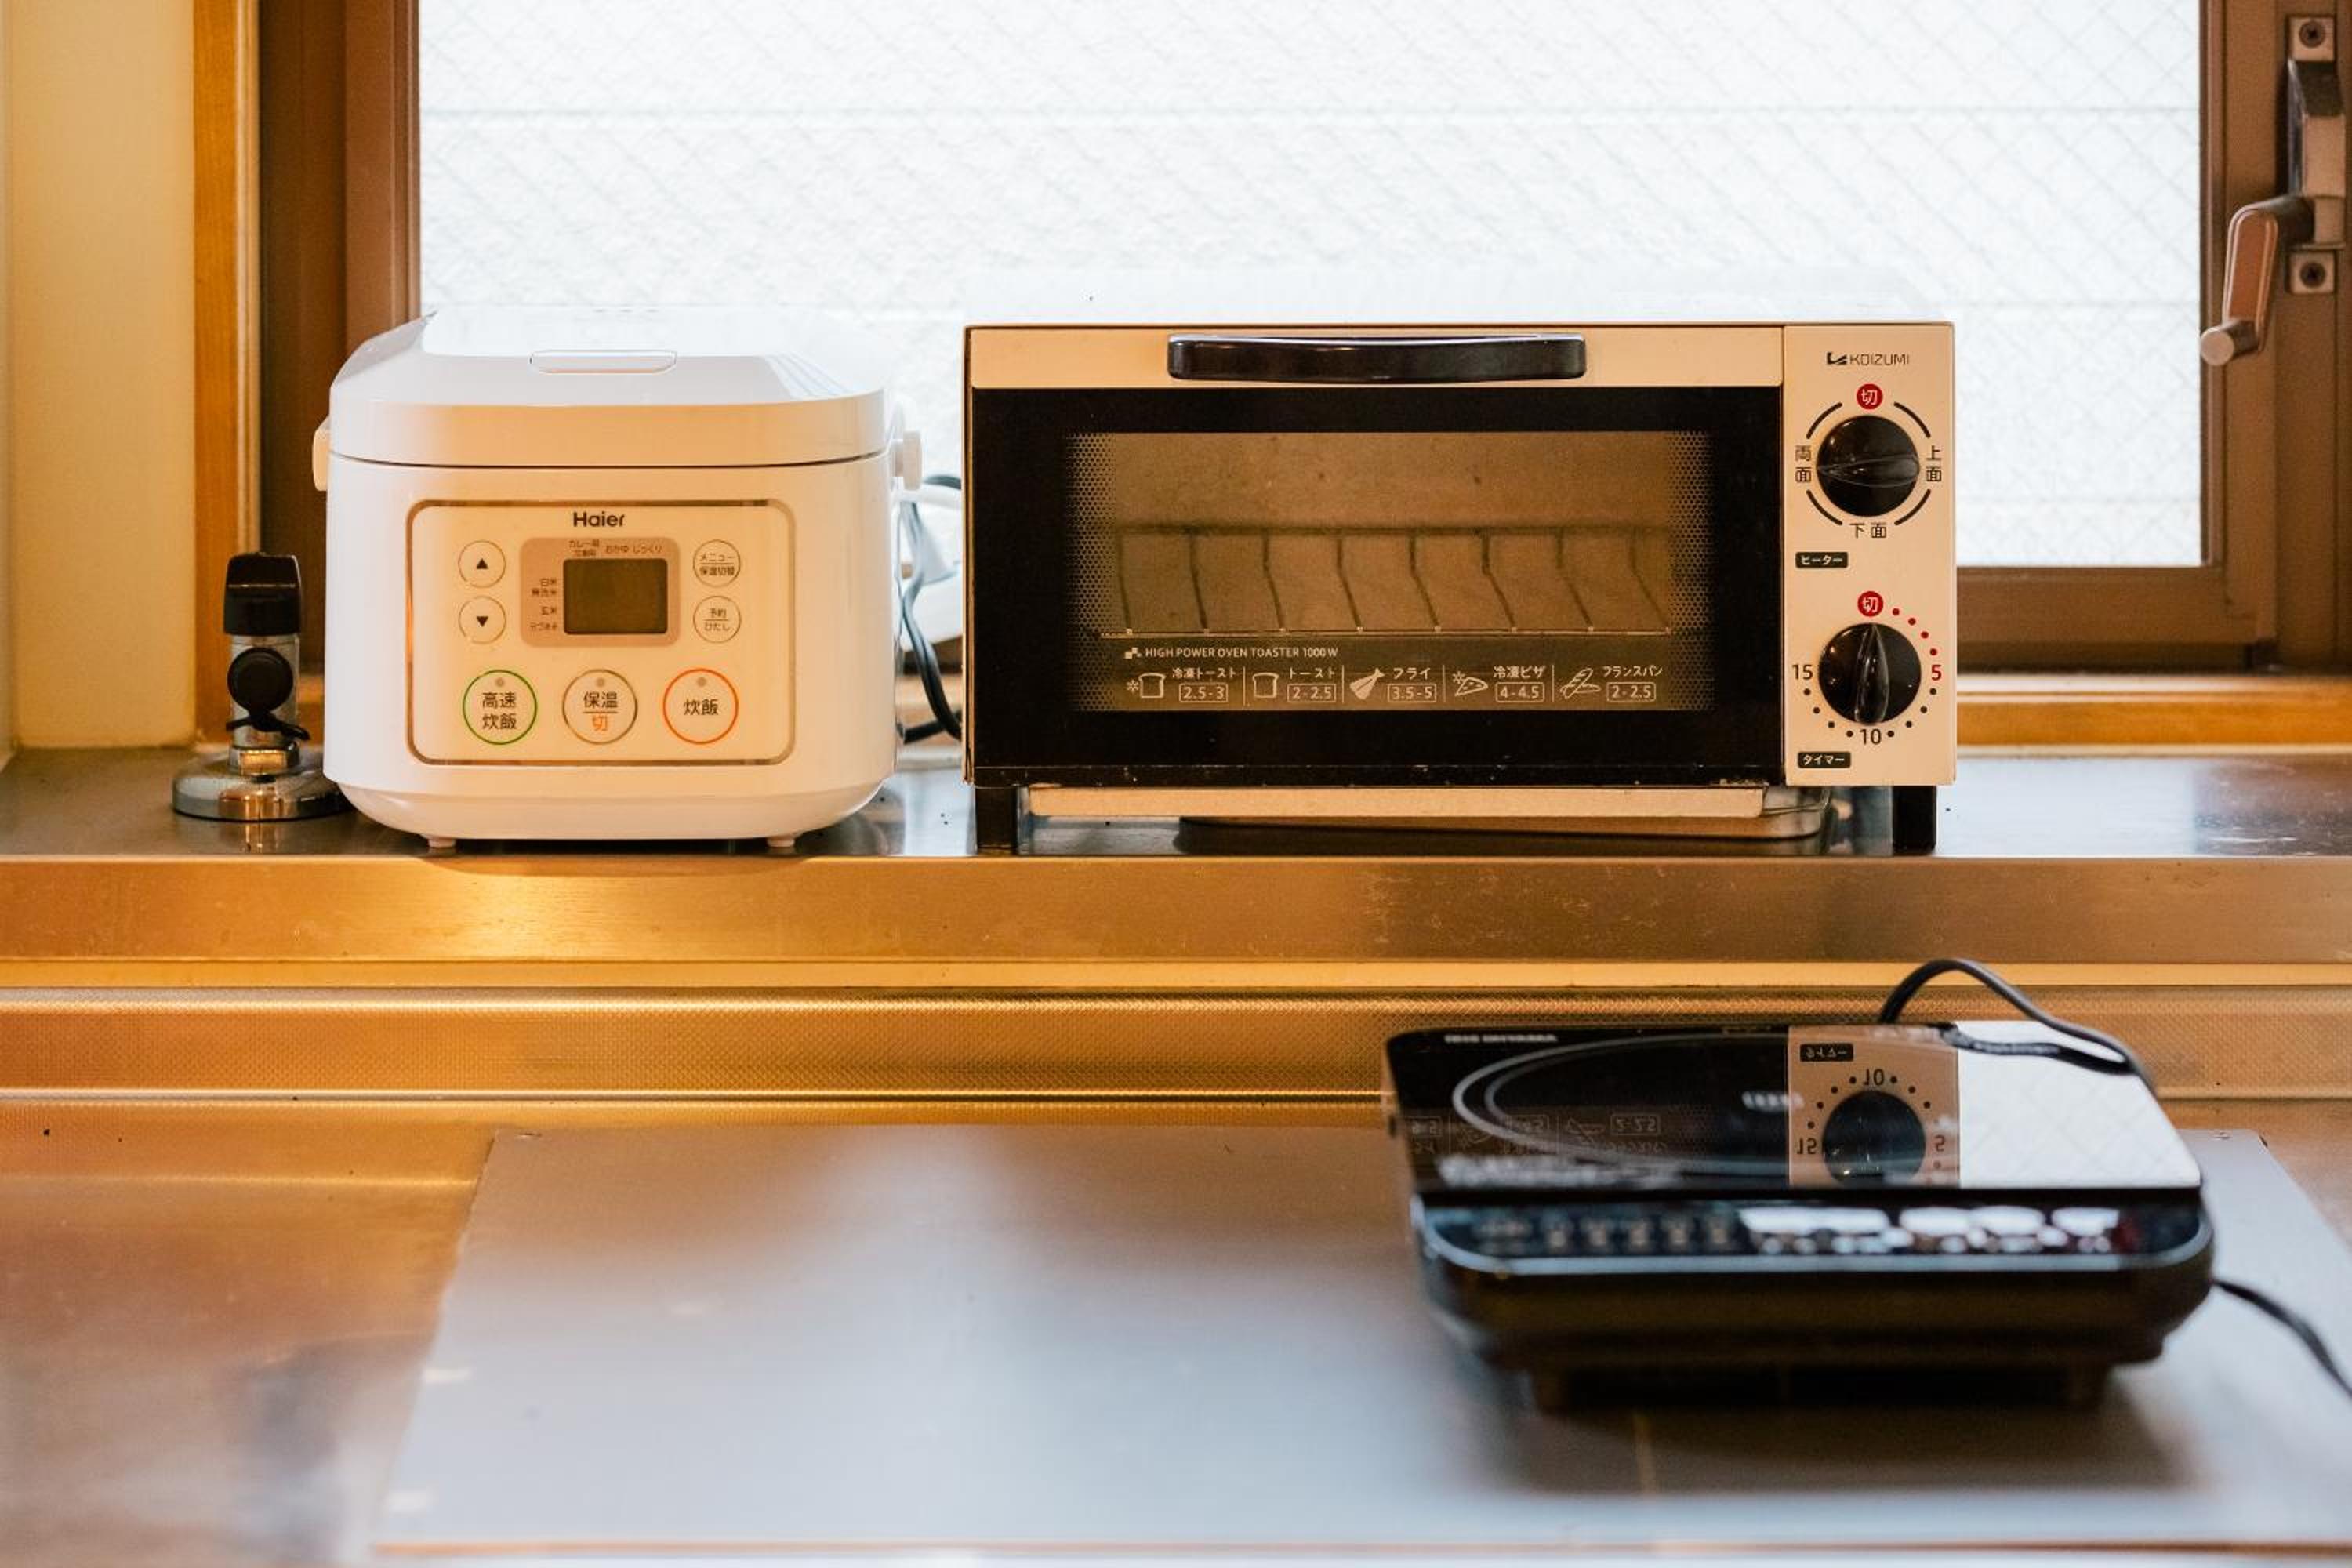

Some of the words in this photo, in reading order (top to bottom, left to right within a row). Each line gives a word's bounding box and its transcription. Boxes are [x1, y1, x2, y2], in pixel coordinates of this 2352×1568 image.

[1850, 354, 1910, 366] KOIZUMI
[1861, 389, 1878, 405] 切
[1795, 445, 1812, 483] 両面
[1926, 445, 1942, 482] 上面
[573, 511, 625, 527] Haier
[1849, 522, 1887, 539] 下面
[699, 553, 735, 562] メニュー
[1800, 554, 1844, 565] ヒーター
[1862, 597, 1878, 613] 切
[709, 608, 728, 619] 予約
[704, 622, 730, 632] ひたし
[1145, 648, 1174, 658] HIGH
[1176, 648, 1215, 658] POWER
[1218, 648, 1247, 658] OVEN
[1251, 648, 1299, 658] TOASTER
[1172, 666, 1236, 679] 冷凍トースト
[1289, 666, 1335, 680] トースト
[1393, 666, 1431, 680] フライ
[1493, 666, 1546, 679] 冷凍ピザ
[1602, 665, 1663, 677] フランスパン
[1791, 664, 1813, 680] 15
[1930, 664, 1942, 681] 5
[481, 691, 517, 710] 高速
[583, 691, 619, 709] 保温
[683, 699, 719, 716] 炊飯
[481, 713, 517, 730] 炊飯
[591, 715, 608, 731] 切
[1859, 728, 1882, 745] 10
[1802, 754, 1845, 765] タイマー
